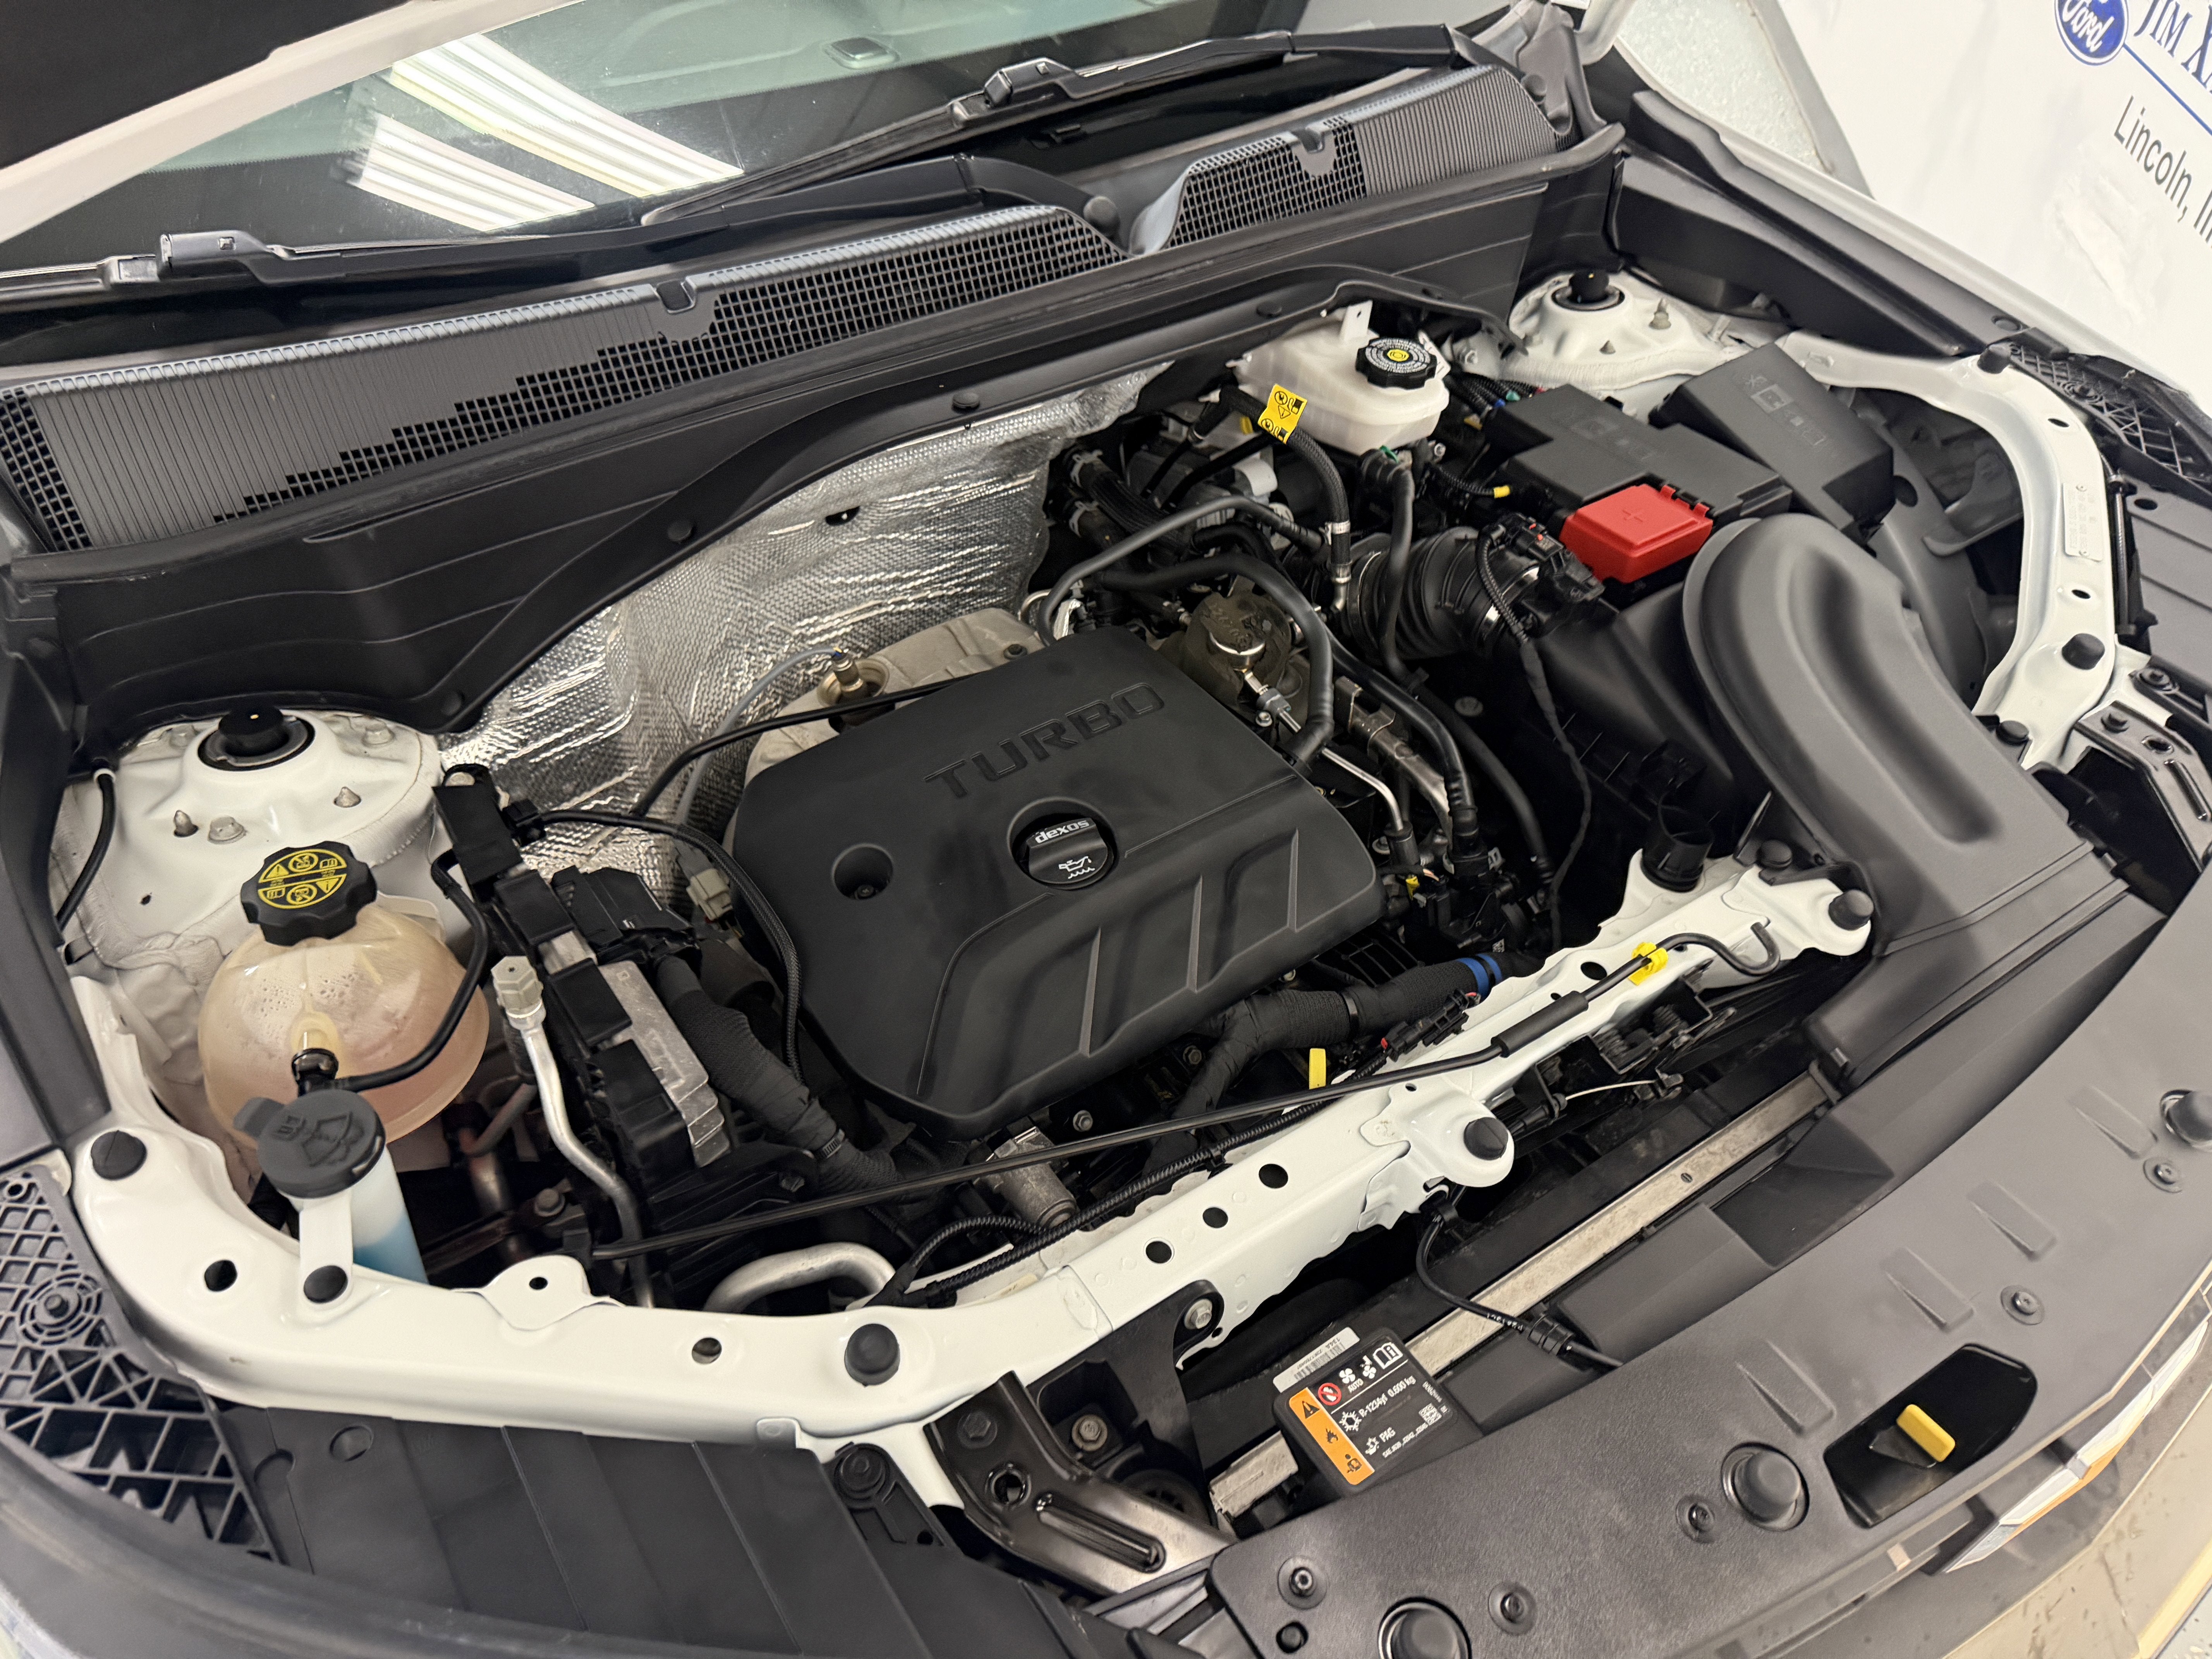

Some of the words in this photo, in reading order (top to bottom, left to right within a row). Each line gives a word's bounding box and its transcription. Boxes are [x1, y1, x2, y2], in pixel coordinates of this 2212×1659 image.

[2133, 0, 2193, 58] JIM
[2114, 95, 2192, 223] Lincoln,
[923, 682, 1164, 799] TURBO
[1035, 820, 1090, 843] dexos
[1348, 1378, 1364, 1393] AUTO
[1404, 1375, 1416, 1386] kg
[1379, 1427, 1396, 1443] PAG
